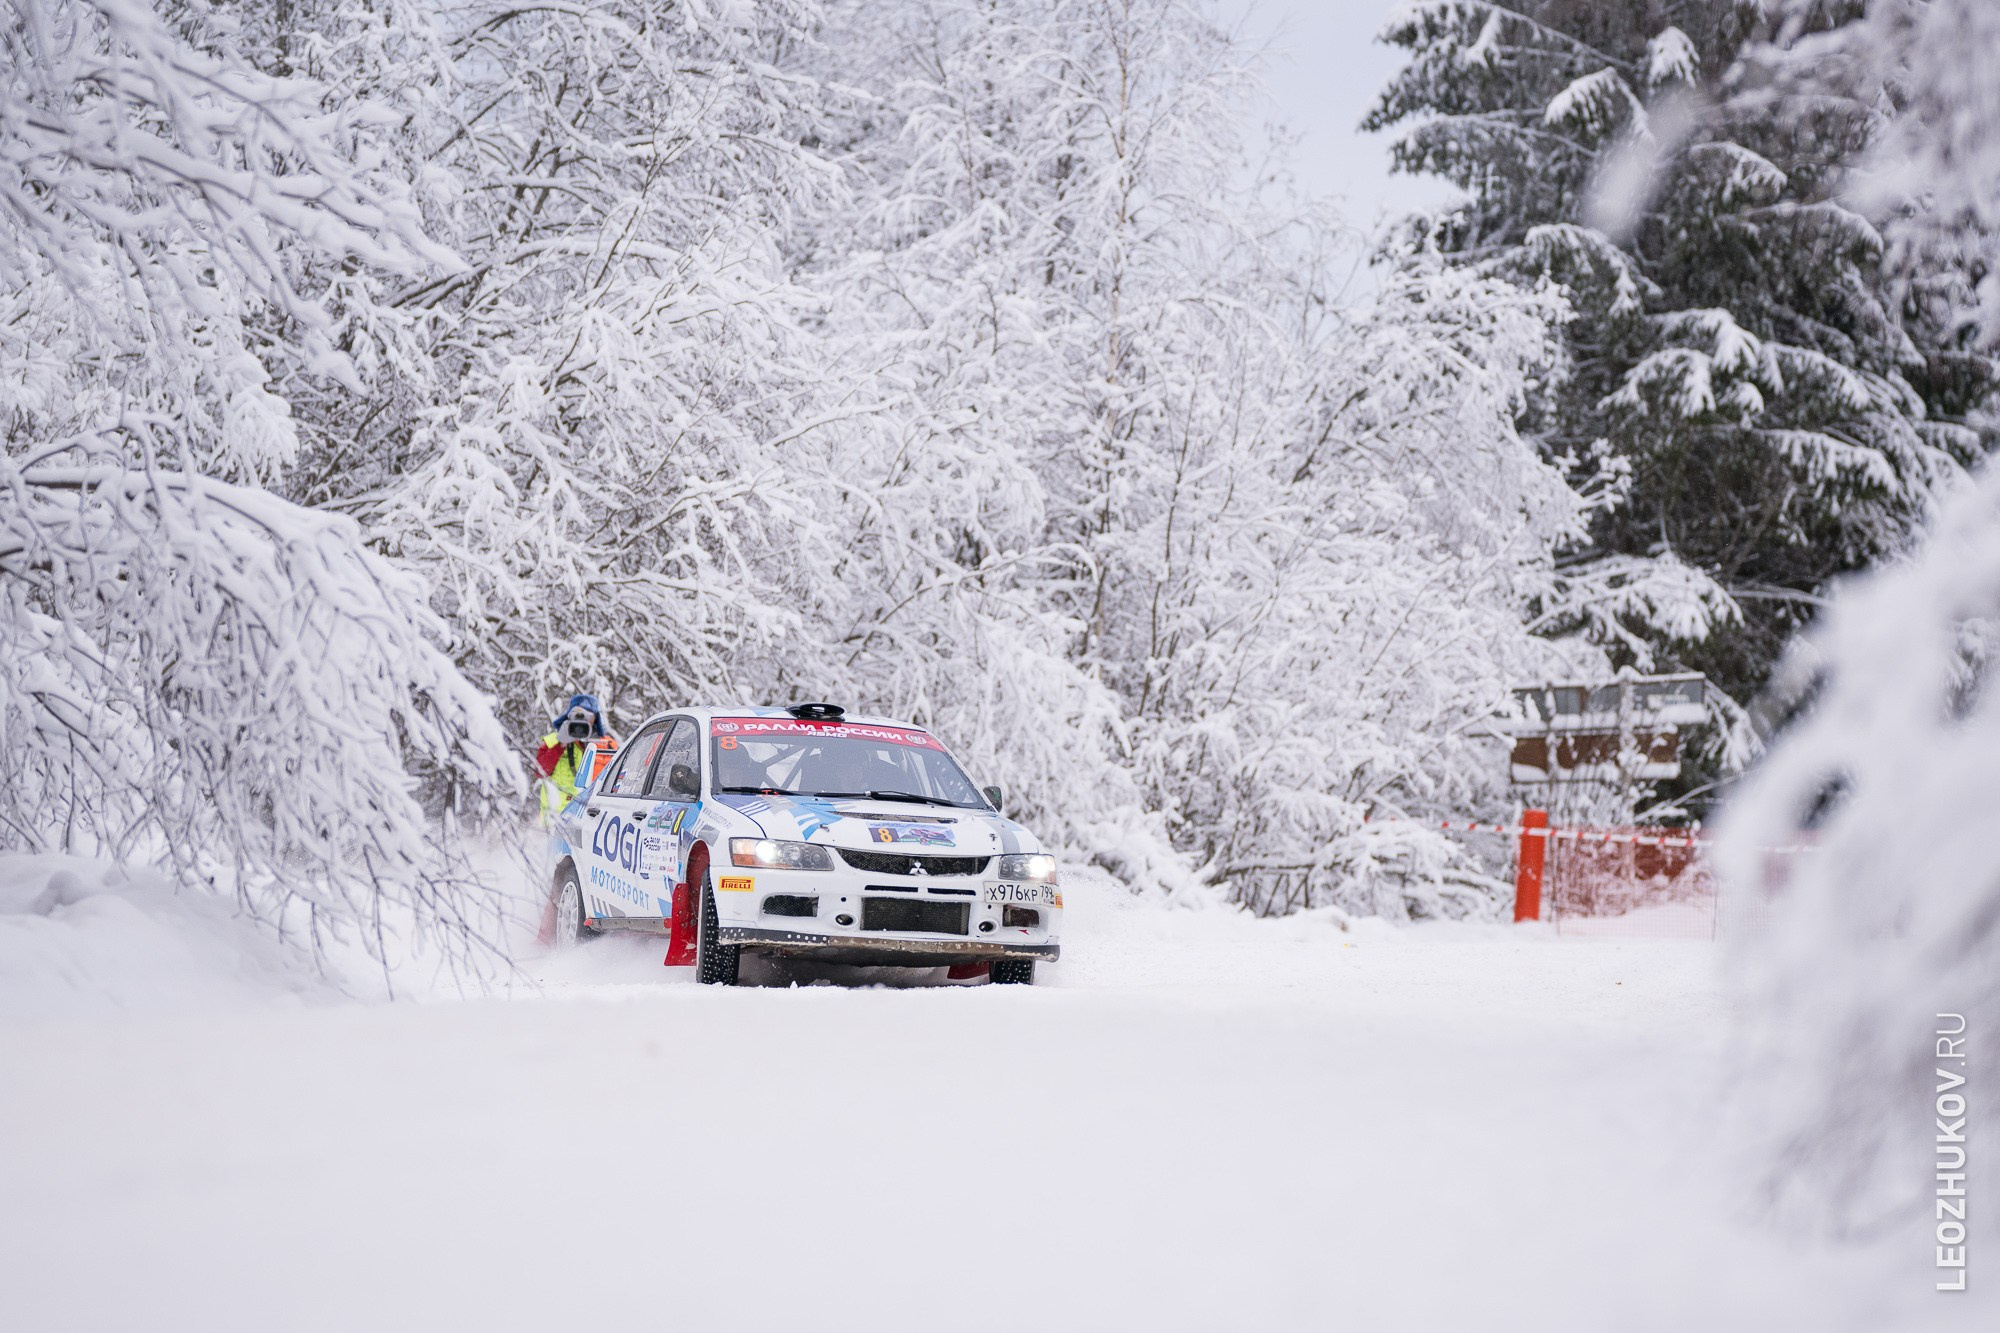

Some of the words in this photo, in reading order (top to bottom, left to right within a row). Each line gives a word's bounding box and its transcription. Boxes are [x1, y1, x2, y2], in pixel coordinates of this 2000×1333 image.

[743, 723, 816, 732] РАЛЛИ
[821, 725, 903, 741] РОССИИ
[720, 736, 738, 750] 8
[878, 828, 893, 843] 8
[591, 865, 650, 911] MOTORSPORT
[721, 878, 752, 889] PIRELLI
